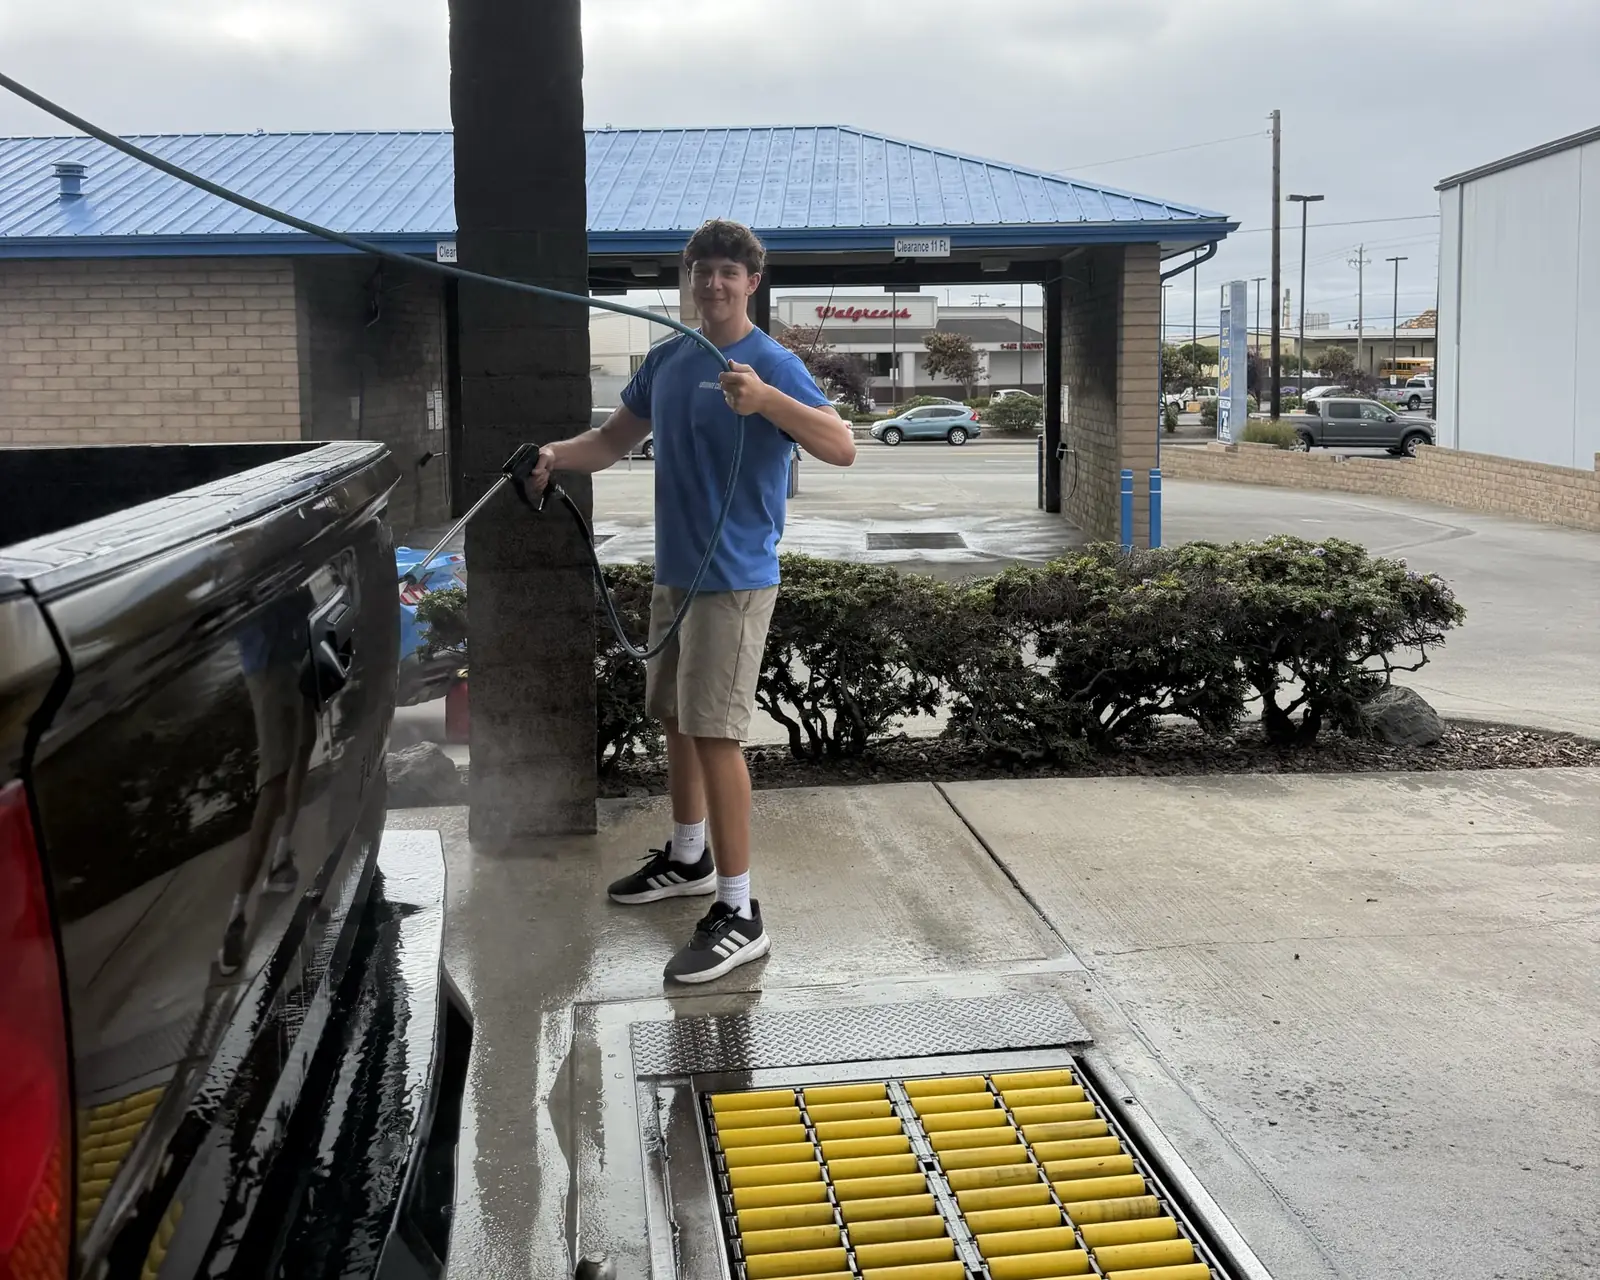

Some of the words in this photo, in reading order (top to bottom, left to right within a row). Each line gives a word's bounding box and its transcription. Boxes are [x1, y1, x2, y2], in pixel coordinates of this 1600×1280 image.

[897, 240, 929, 253] Clearance
[930, 240, 938, 252] 11
[815, 306, 912, 322] Walgreens
